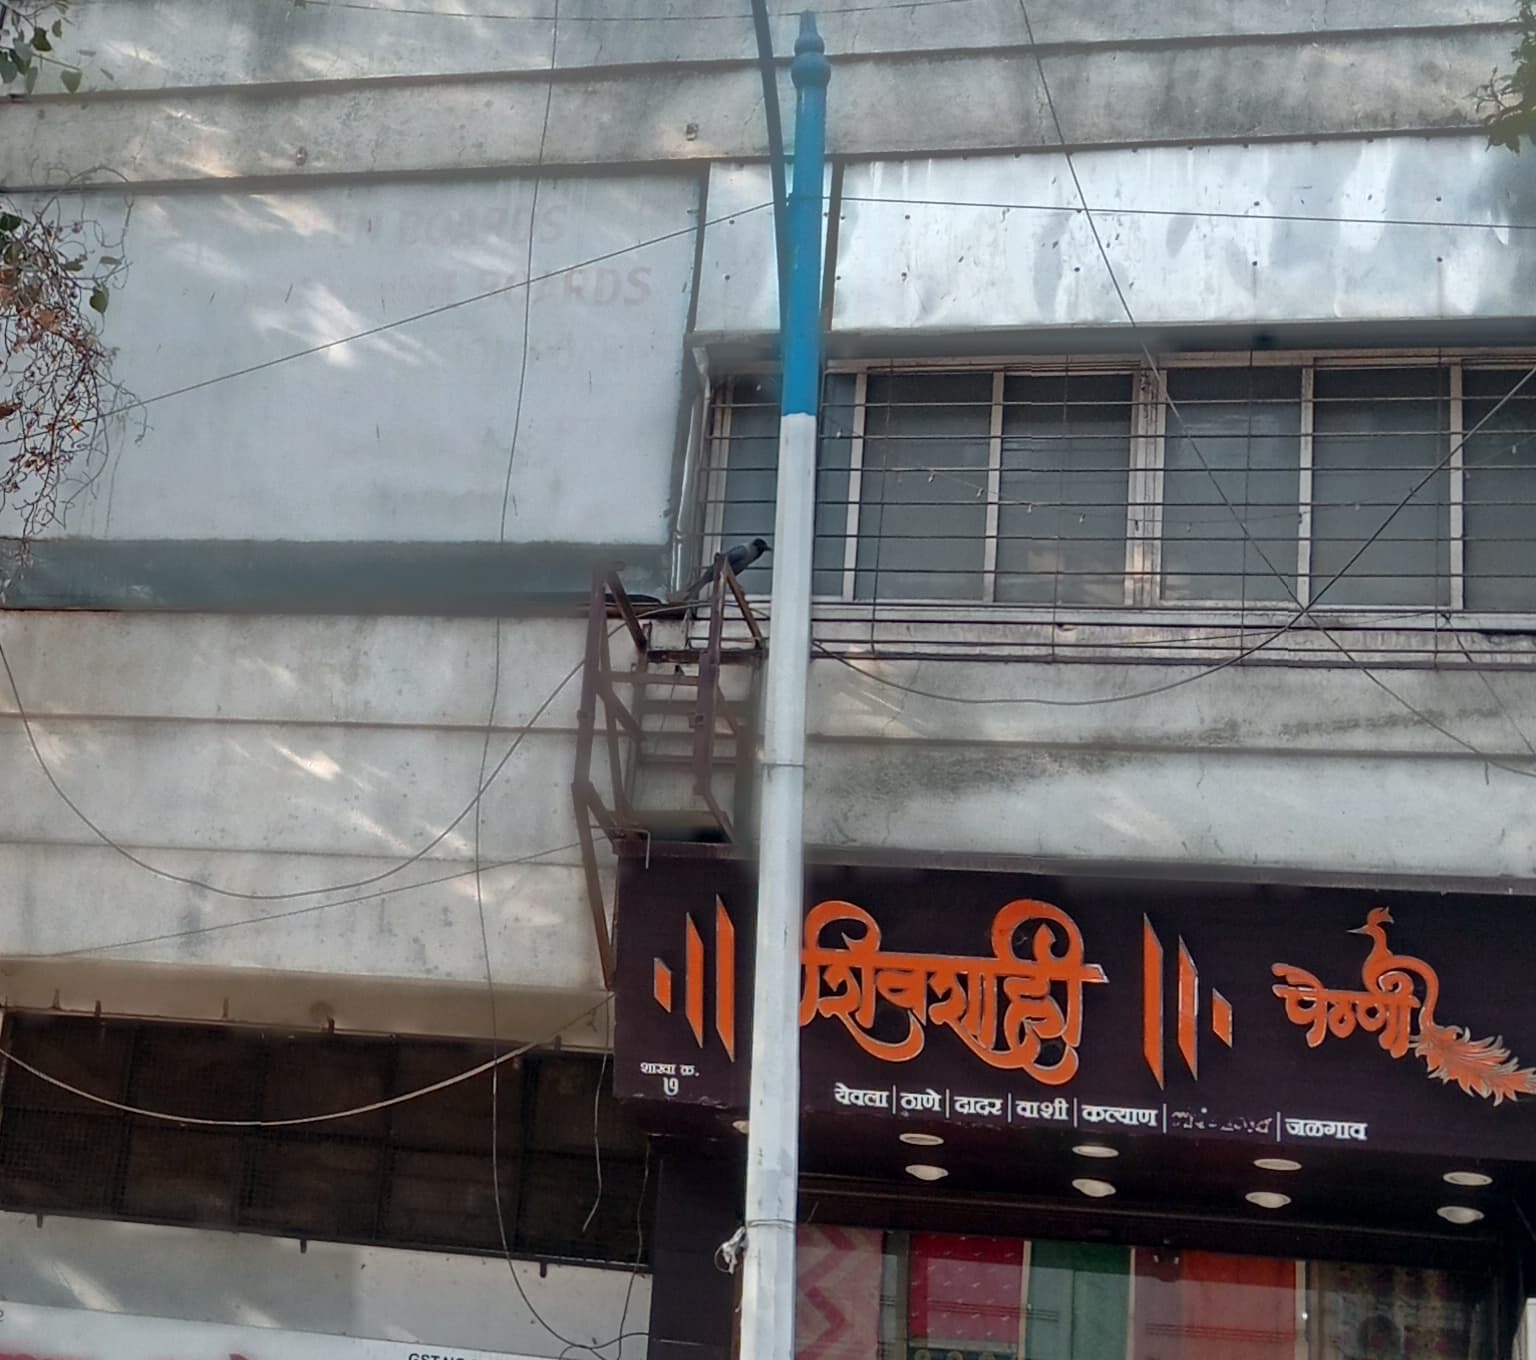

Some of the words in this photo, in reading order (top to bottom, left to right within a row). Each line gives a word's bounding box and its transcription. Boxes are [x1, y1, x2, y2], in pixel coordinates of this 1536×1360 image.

[834, 1082, 890, 1109] येवला
[900, 1089, 942, 1112] ठाणे
[954, 1096, 1003, 1117] दादर
[1016, 1098, 1069, 1120] वाशी
[1081, 1104, 1158, 1127] कल्याण
[1285, 1118, 1367, 1140] जळगाव
